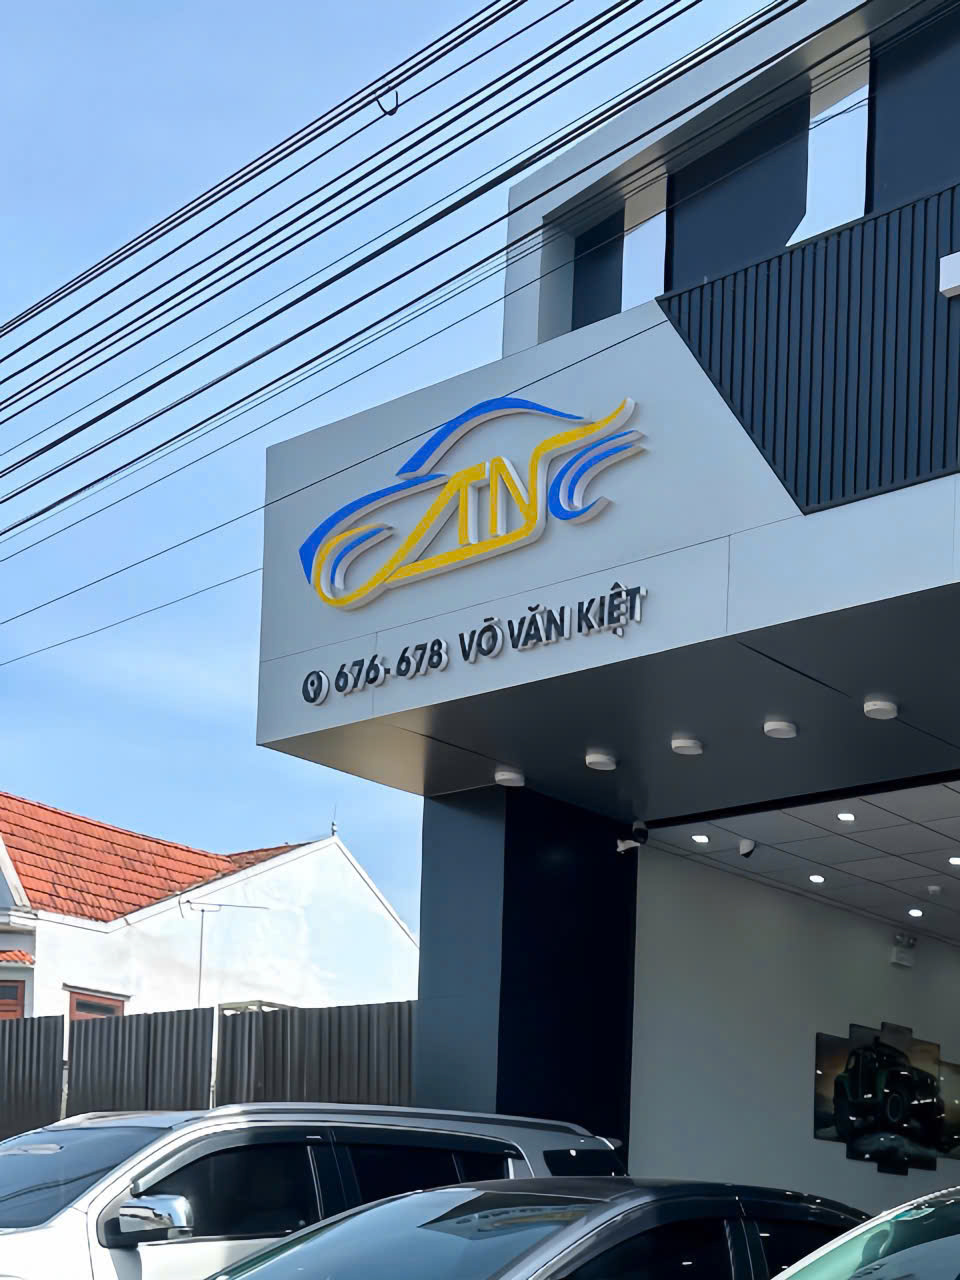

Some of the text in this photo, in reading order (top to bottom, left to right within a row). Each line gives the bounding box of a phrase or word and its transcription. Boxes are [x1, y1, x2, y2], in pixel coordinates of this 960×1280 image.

[458, 616, 505, 663] VÕ
[507, 605, 572, 651] VĂN
[576, 581, 648, 638] KIỆT
